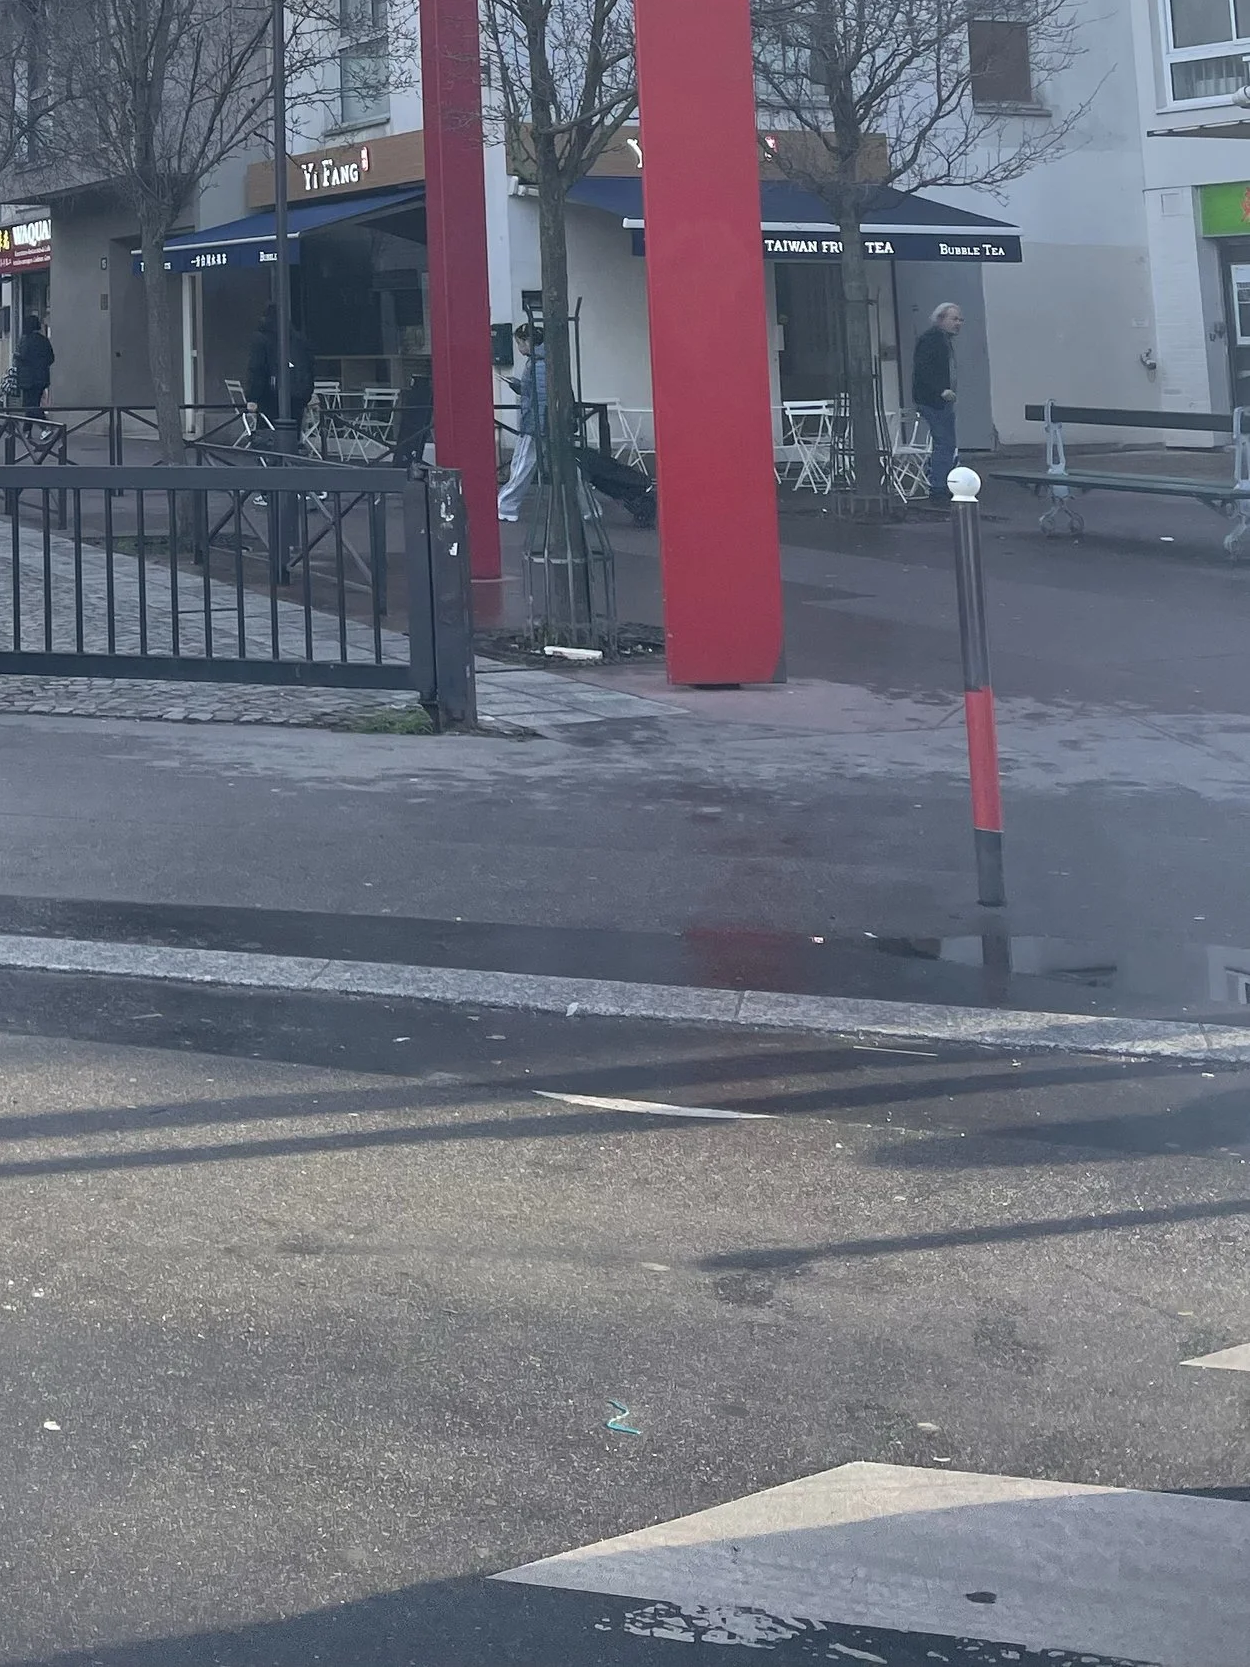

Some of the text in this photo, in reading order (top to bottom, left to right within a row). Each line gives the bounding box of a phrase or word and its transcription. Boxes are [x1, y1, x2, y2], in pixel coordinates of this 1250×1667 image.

[321, 158, 359, 187] FANG
[764, 239, 818, 253] TAIWAN
[865, 242, 895, 254] TEA
